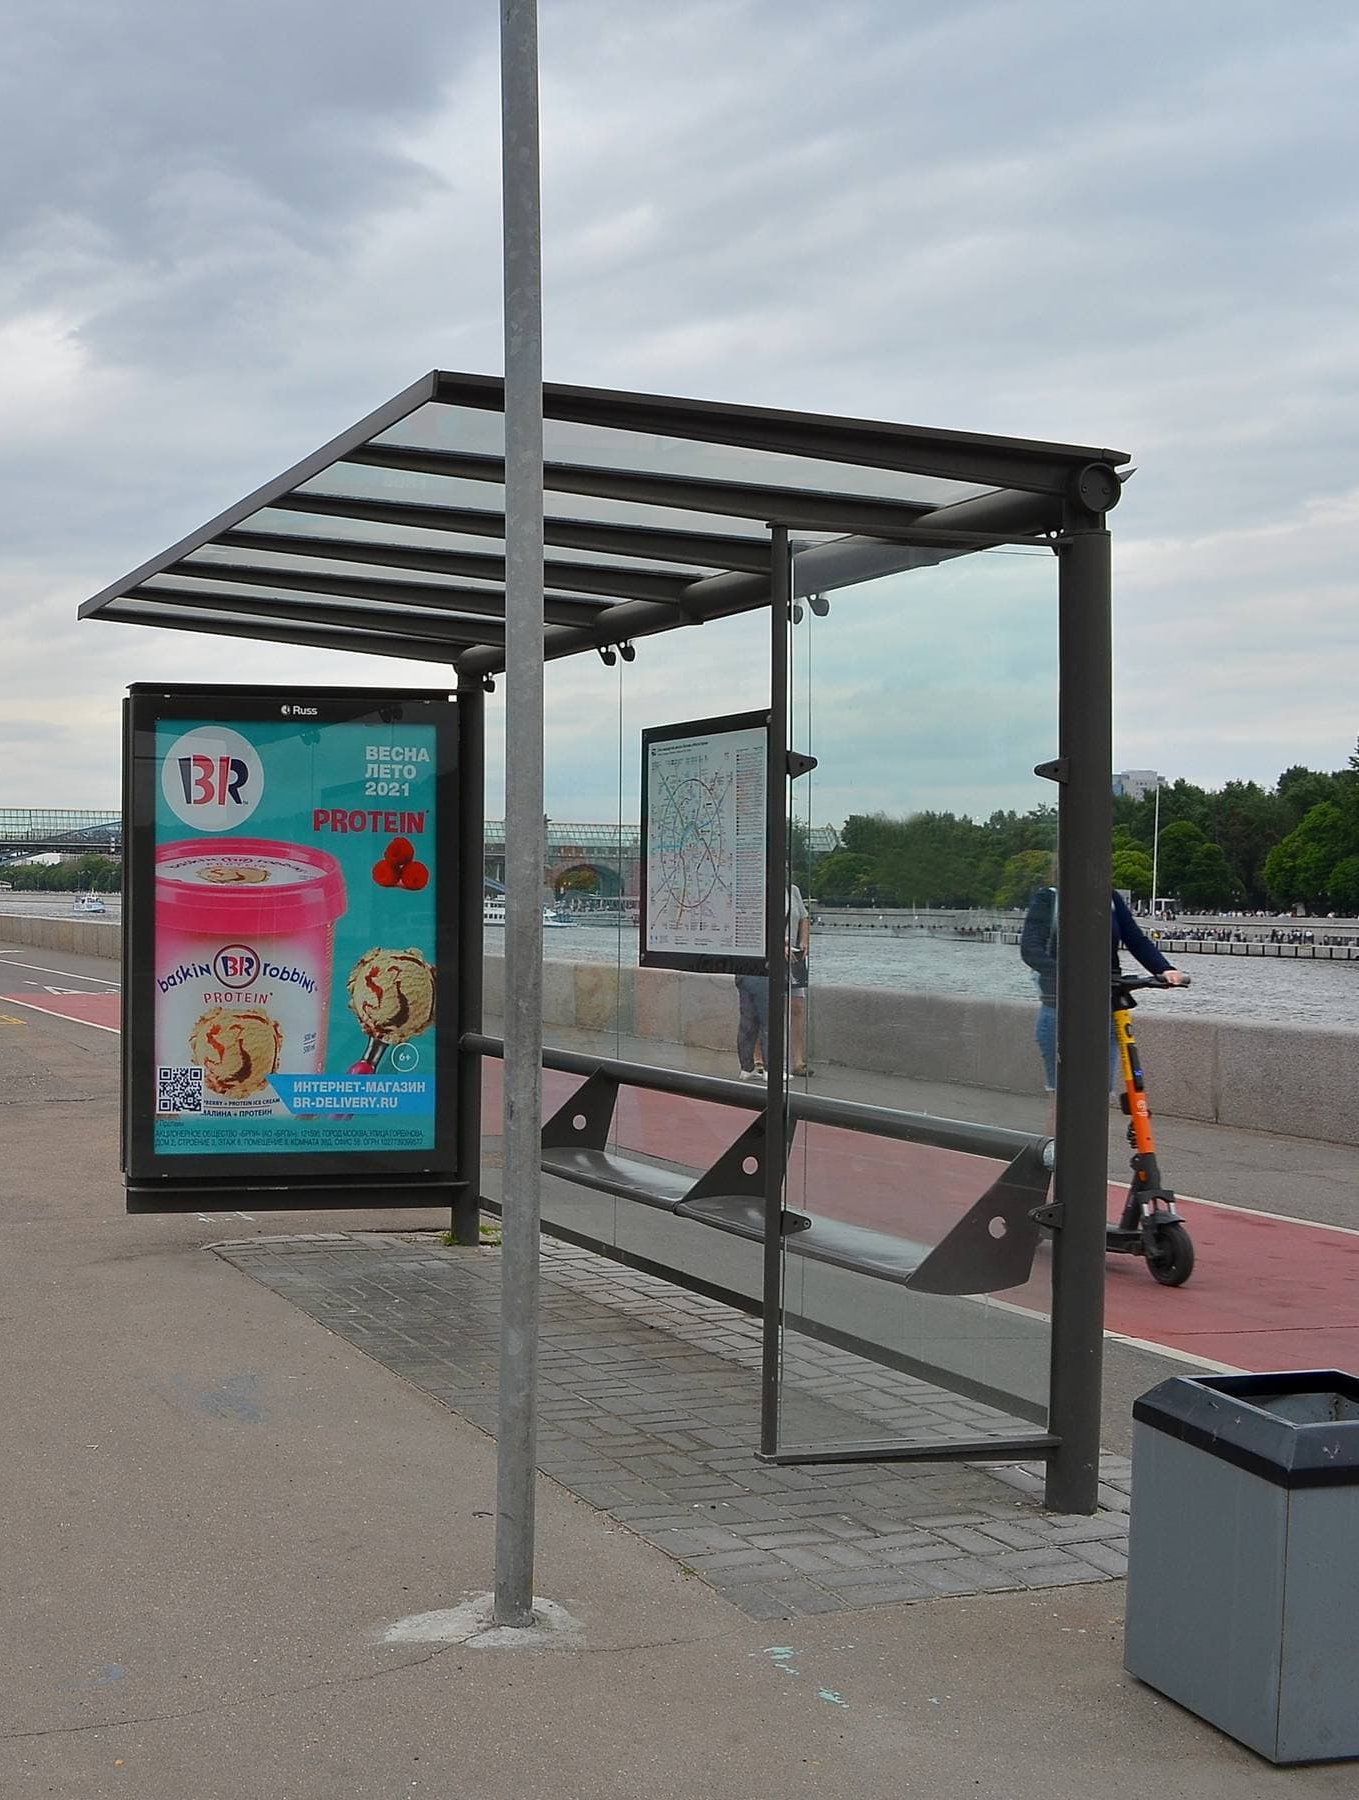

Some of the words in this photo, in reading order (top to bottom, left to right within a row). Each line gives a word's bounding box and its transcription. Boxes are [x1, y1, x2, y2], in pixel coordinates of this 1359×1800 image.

[293, 706, 318, 716] Russ
[365, 746, 430, 762] ВЕСНА
[365, 764, 417, 780] ЛЕТО
[178, 754, 249, 805] BR
[365, 781, 410, 797] 2021
[157, 963, 212, 993] baskin
[221, 955, 255, 977] BR
[262, 962, 316, 994] robbins
[399, 1053, 411, 1061] 6+
[293, 1081, 426, 1093] ИНТЕРНЕТ-МАГАЗИН
[293, 1097, 398, 1108] BR-DELIVERY.RU
[239, 1109, 272, 1117] ПРОТЕИН
